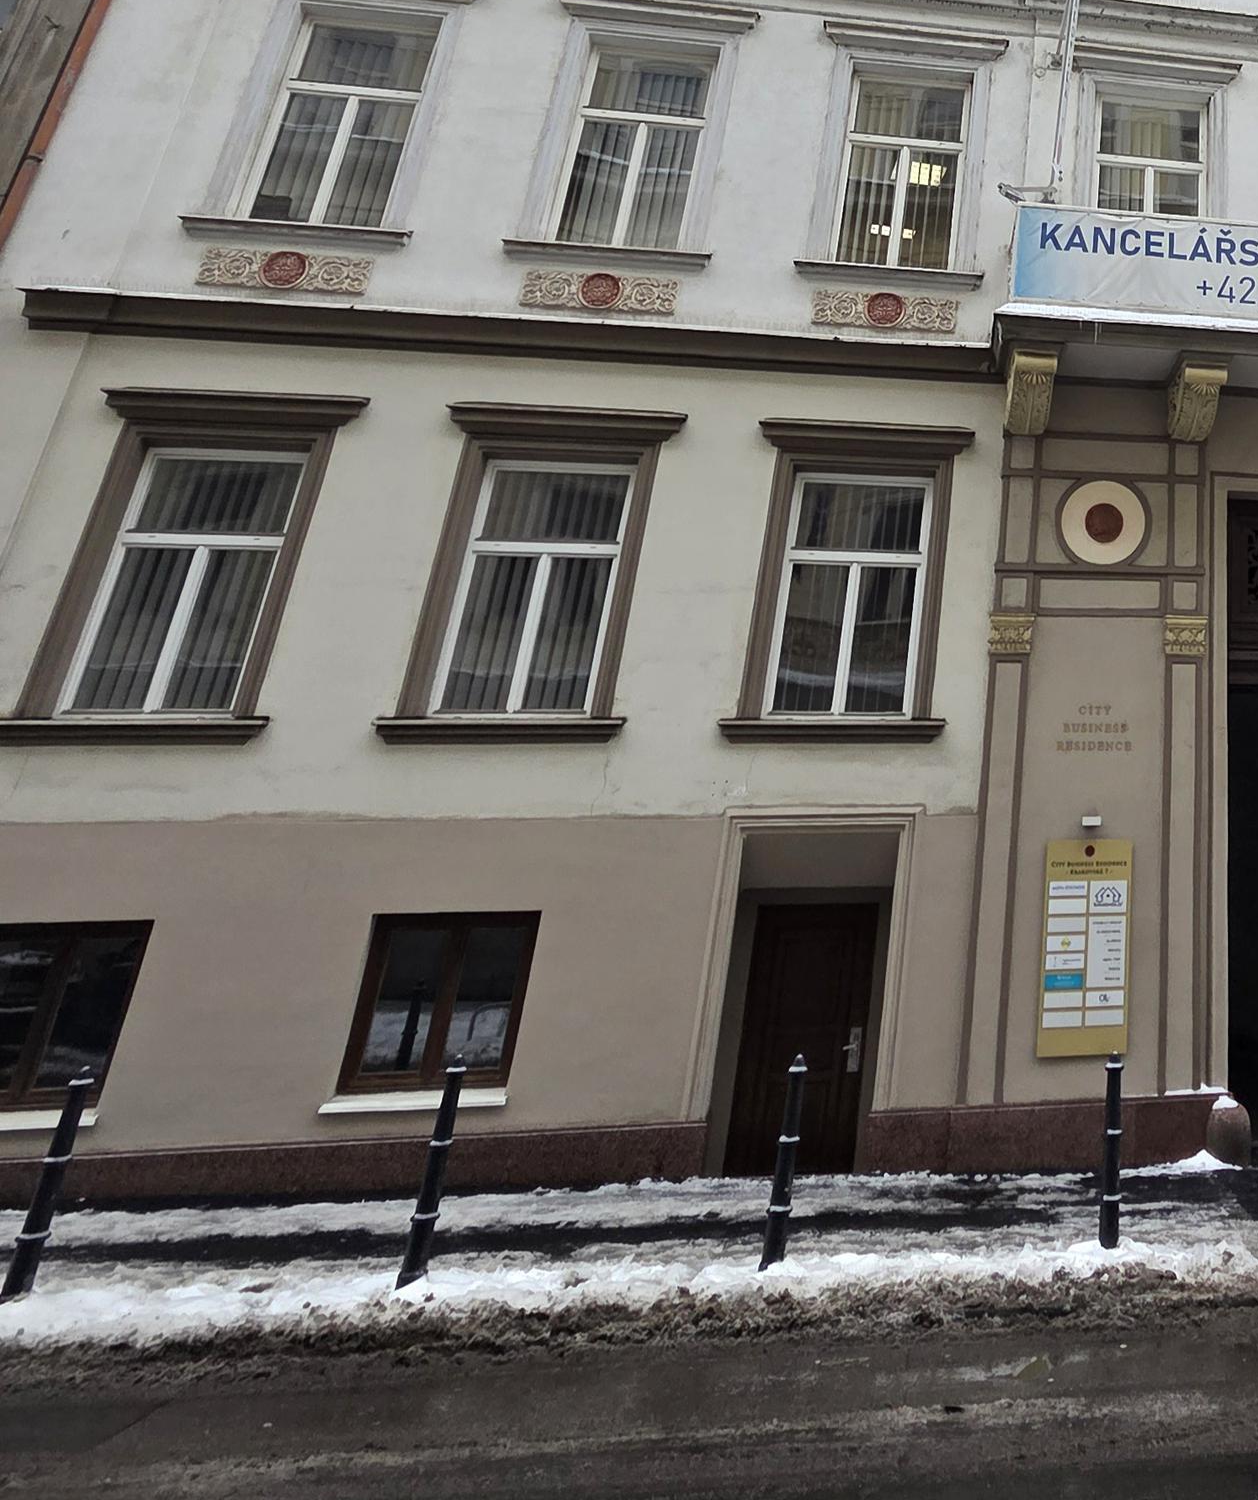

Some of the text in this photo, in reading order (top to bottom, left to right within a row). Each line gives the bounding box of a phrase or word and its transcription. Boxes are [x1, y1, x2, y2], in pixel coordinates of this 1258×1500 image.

[1078, 704, 1112, 716] CITY
[1063, 722, 1128, 734] BUSINESS
[1056, 740, 1132, 752] RESIDENCE
